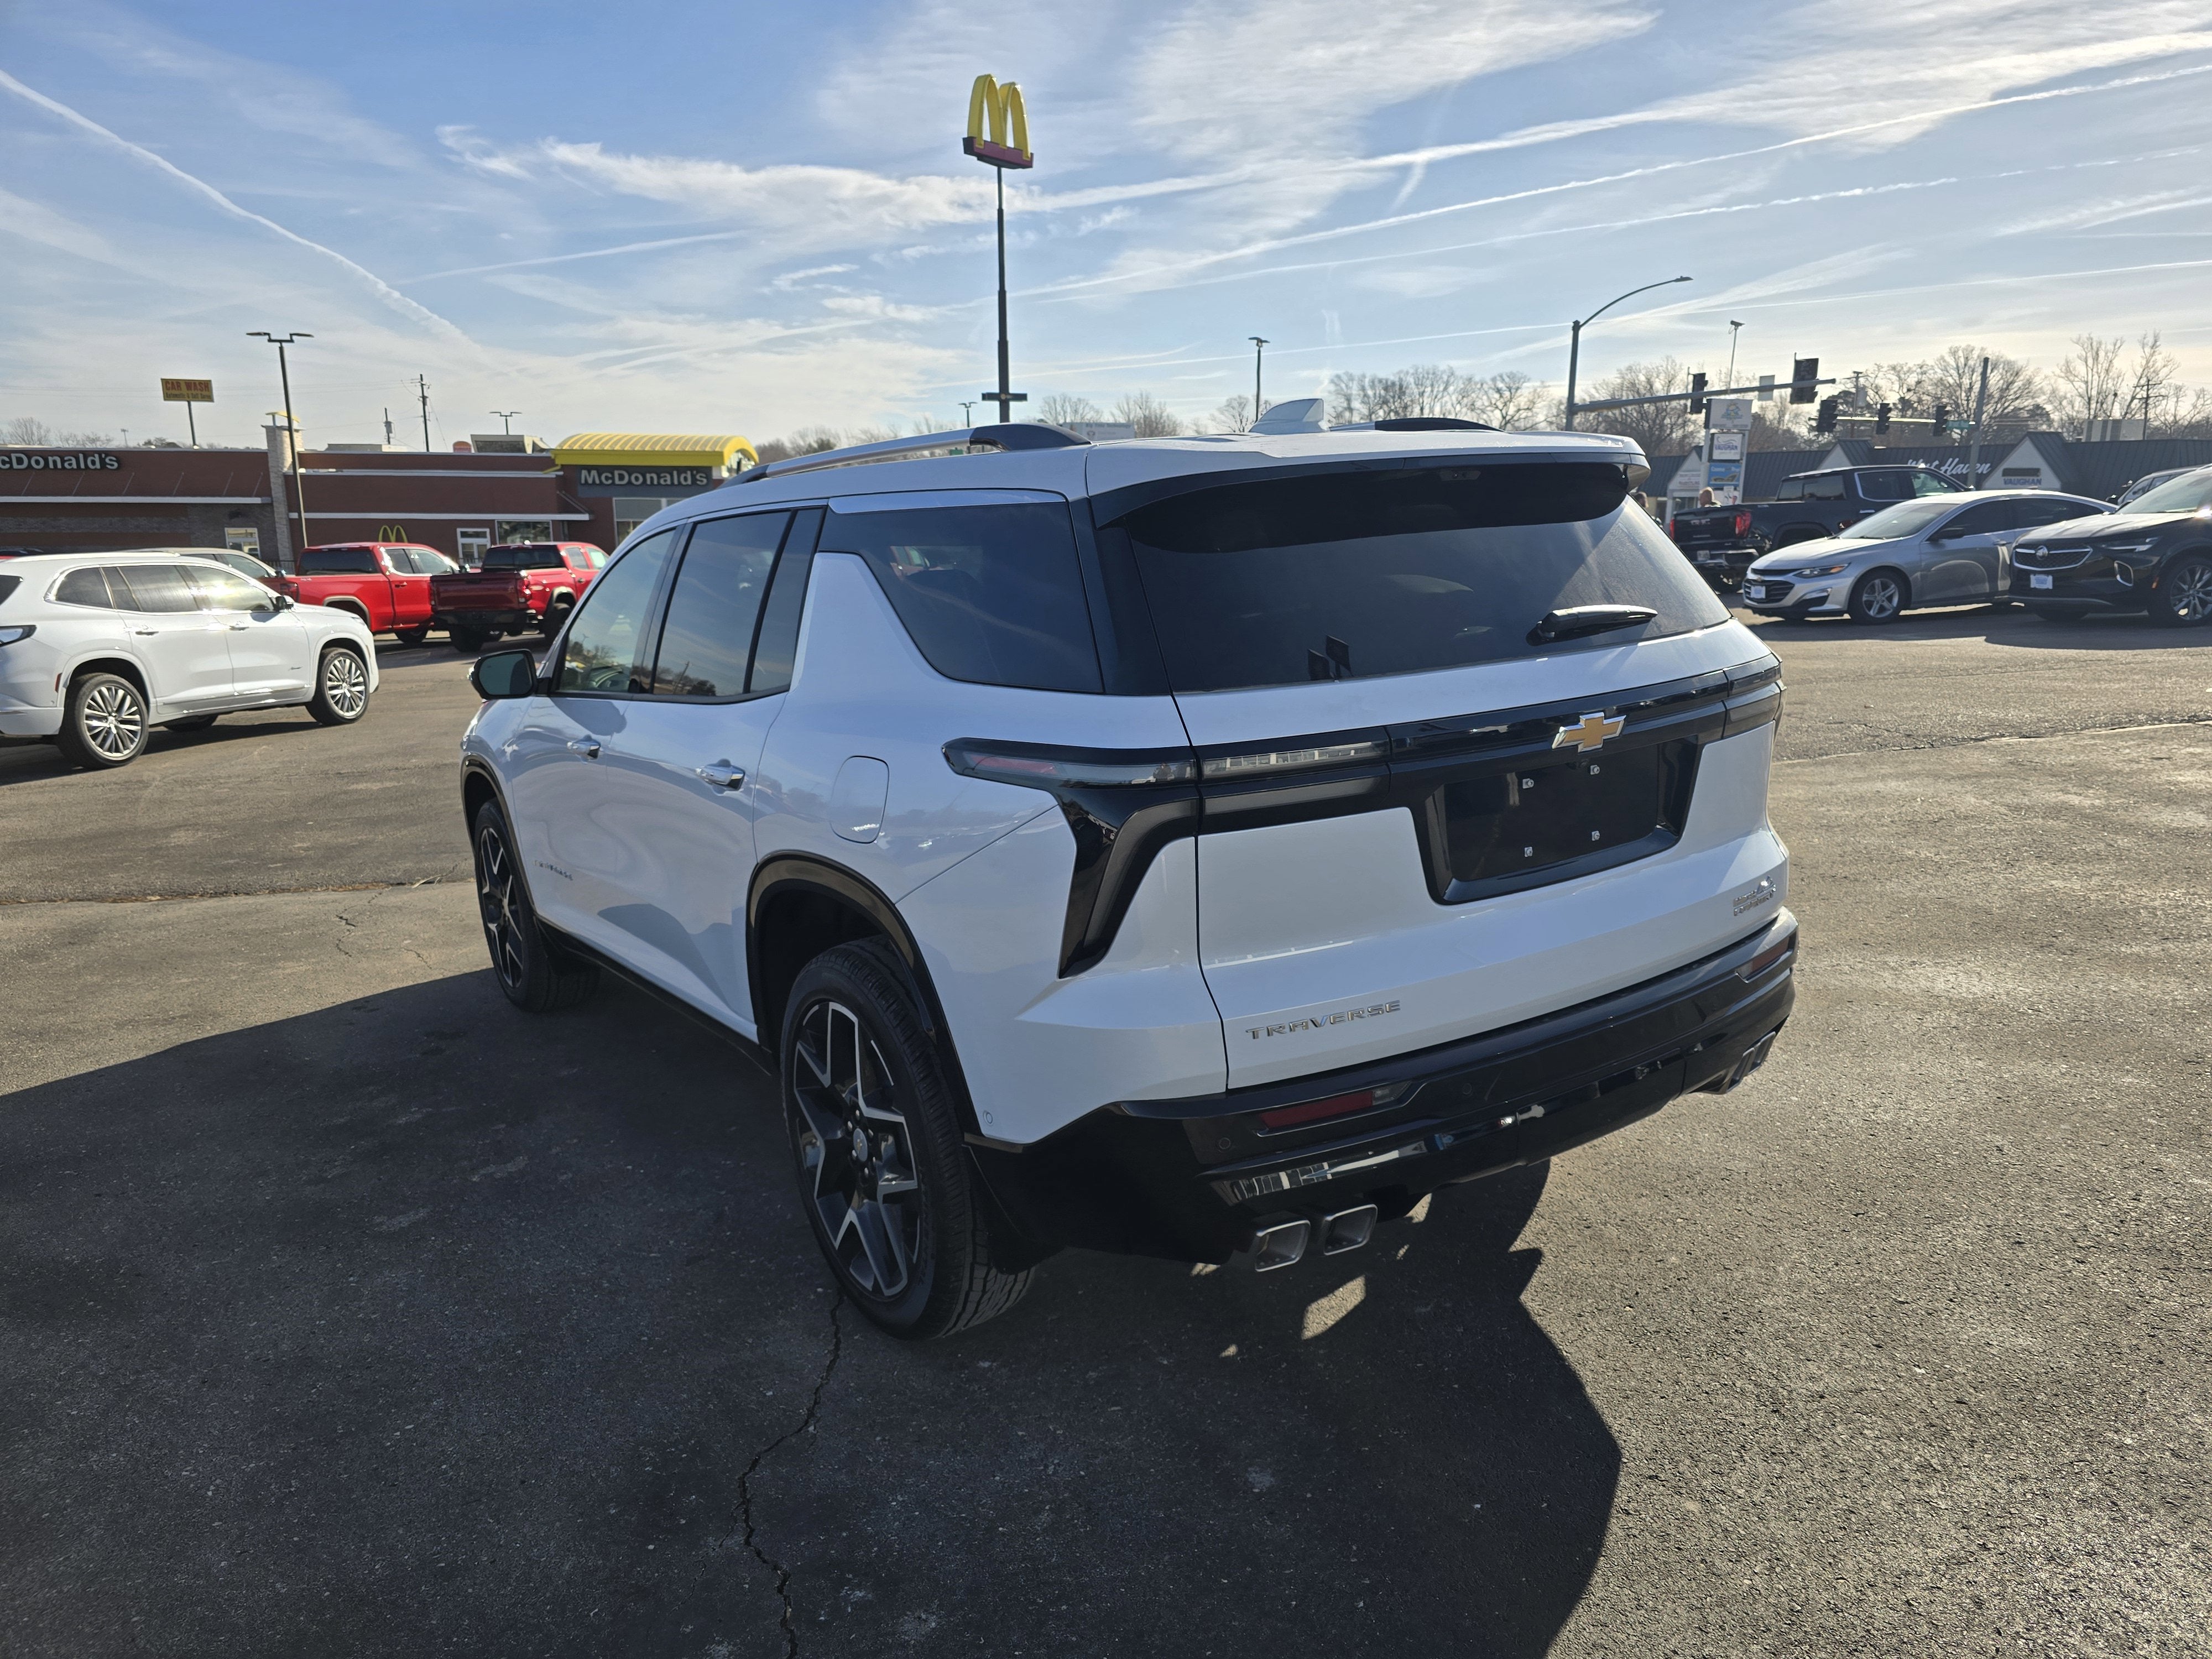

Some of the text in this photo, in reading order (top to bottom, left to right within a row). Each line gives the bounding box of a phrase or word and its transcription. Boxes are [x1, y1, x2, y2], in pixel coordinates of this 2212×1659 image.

[165, 381, 210, 392] CAR WASH
[0, 453, 119, 469] cDonald's
[581, 469, 707, 485] McDonald's
[1245, 1000, 1401, 1039] TRAVERSE
